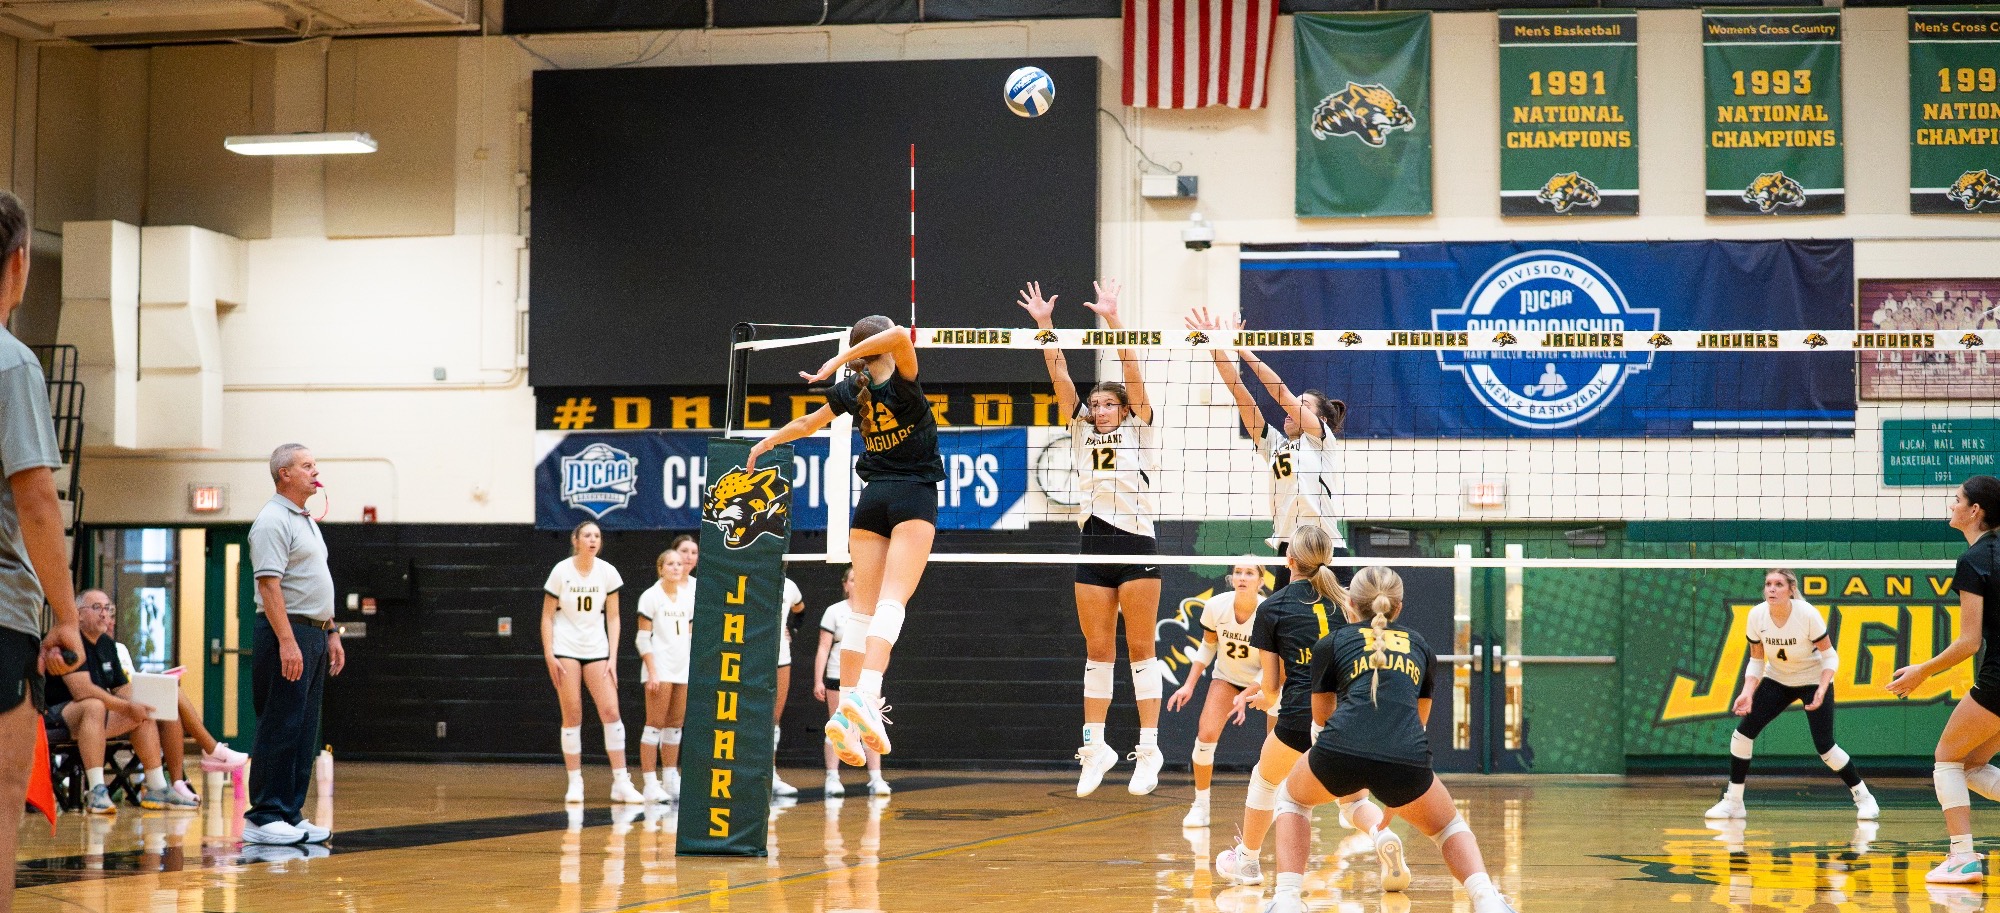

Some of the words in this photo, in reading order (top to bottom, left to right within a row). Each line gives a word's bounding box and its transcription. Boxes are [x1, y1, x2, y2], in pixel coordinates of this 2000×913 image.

[1514, 25, 1551, 37] Men's
[1554, 25, 1621, 37] Basketball
[1708, 24, 1757, 36] Women's
[1758, 24, 1790, 35] Cross
[1791, 24, 1836, 37] Country
[1914, 22, 1949, 33] Men's
[1951, 22, 1987, 33] Cross
[1528, 70, 1606, 96] 1991
[1731, 69, 1812, 96] 1993
[1512, 105, 1624, 124] NATIONAL
[1717, 104, 1828, 123] NATIONAL
[1506, 131, 1631, 149] CHAMPIONS
[1711, 130, 1836, 148] CHAMPIONS
[1498, 265, 1575, 290] DIVISION
[1581, 276, 1594, 290] II
[1519, 288, 1573, 316] NJCAA
[931, 329, 1012, 345] JAGUARS
[1081, 329, 1162, 346] JAGUARS
[1232, 330, 1315, 347] JAGUARS
[1386, 331, 1469, 347] JAGUARS
[1540, 331, 1624, 348] JAGUARS
[1696, 332, 1779, 349] JAGUARS
[1851, 332, 1935, 349] JAGUARS
[1484, 377, 1523, 410] MEN'S
[1528, 377, 1608, 416] BASKETBALL
[864, 400, 899, 433] 12
[1931, 422, 1953, 434] DACC
[1899, 439, 1927, 450] NJCAA
[1091, 447, 1116, 470] 12
[1272, 452, 1292, 480] 15
[1890, 455, 1942, 466] BASKETBALL
[1948, 454, 1995, 466] CHAMPIONS
[568, 461, 629, 492] NJCAA
[196, 489, 218, 509] EXIT
[577, 595, 593, 612] 10
[675, 619, 680, 636] 1
[1312, 602, 1330, 640] 1
[1222, 629, 1251, 642] PARKLA
[1358, 627, 1411, 655] 16
[1765, 636, 1797, 646] PARKLAND
[1226, 641, 1250, 660] 23
[1776, 647, 1788, 662] 4
[708, 574, 748, 838] JAGUARS
